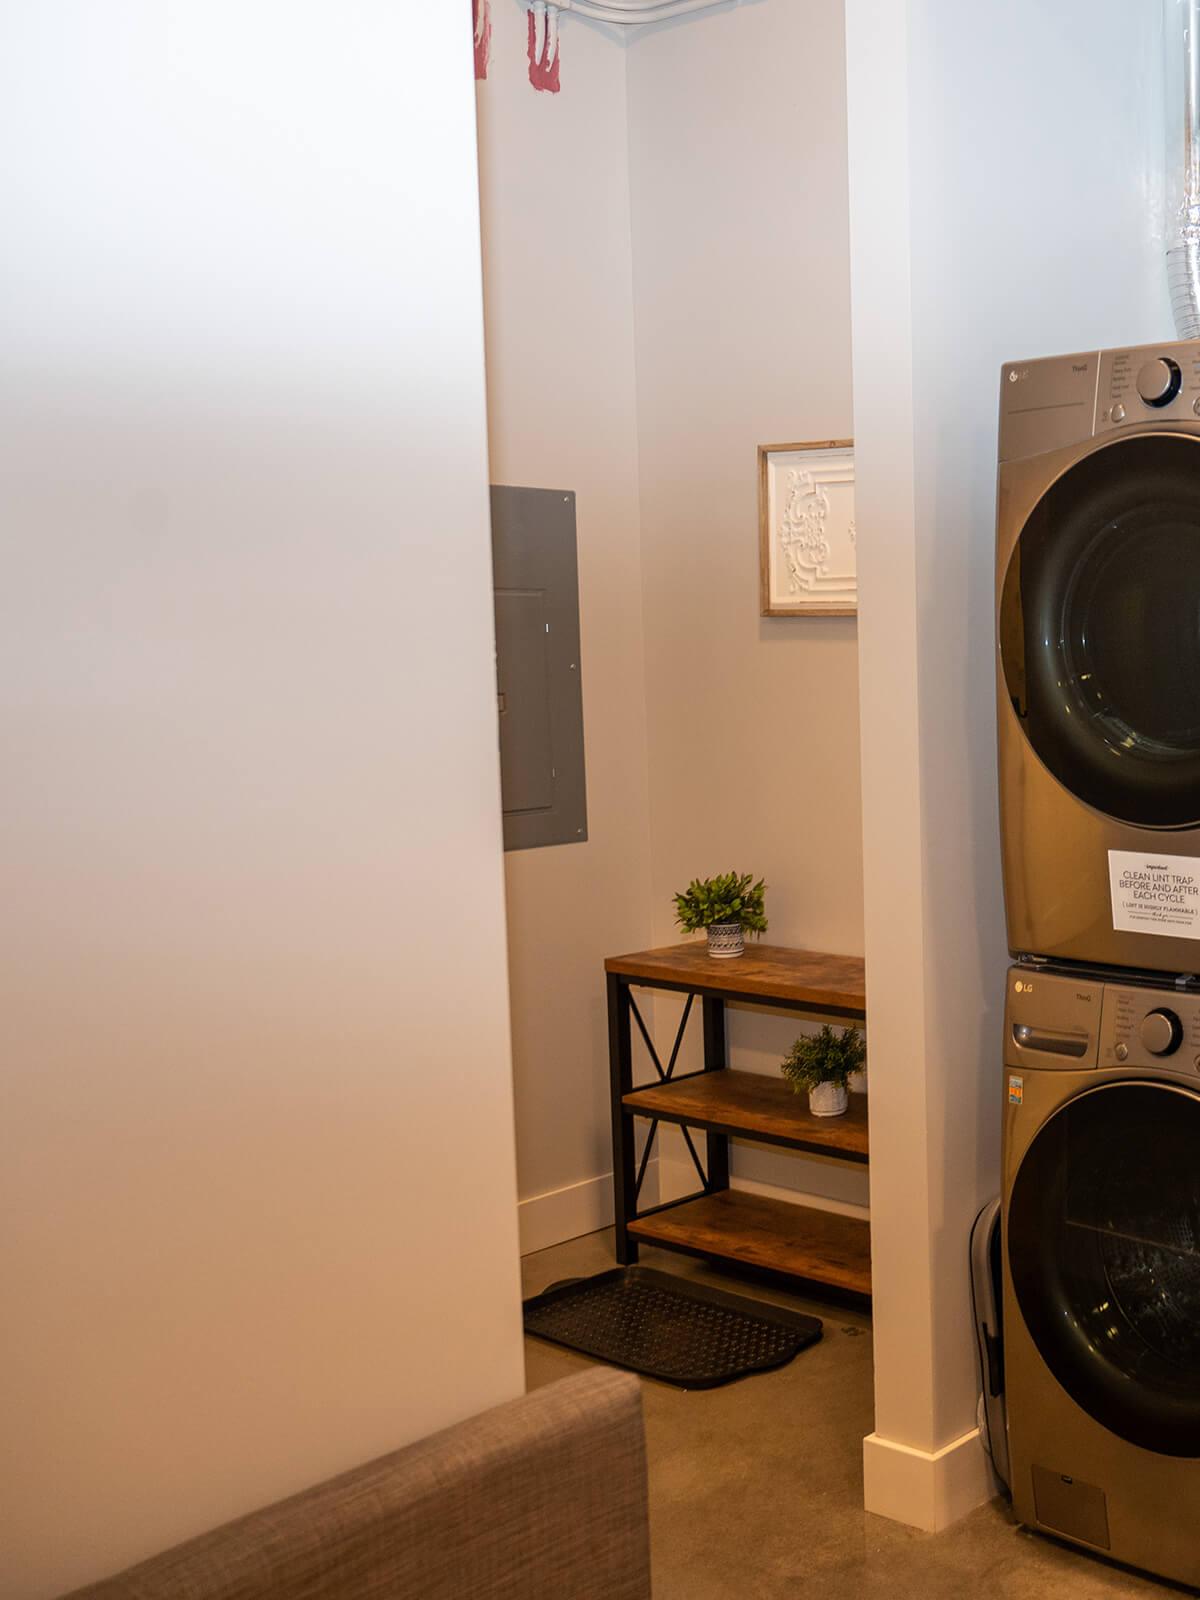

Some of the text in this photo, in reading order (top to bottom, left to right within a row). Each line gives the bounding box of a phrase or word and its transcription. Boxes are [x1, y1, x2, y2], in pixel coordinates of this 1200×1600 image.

[1123, 870, 1194, 885] CLEAN LINT TRAP
[1119, 879, 1199, 895] BEFORE AND AFTER
[1133, 890, 1185, 904] EACH CYCLE
